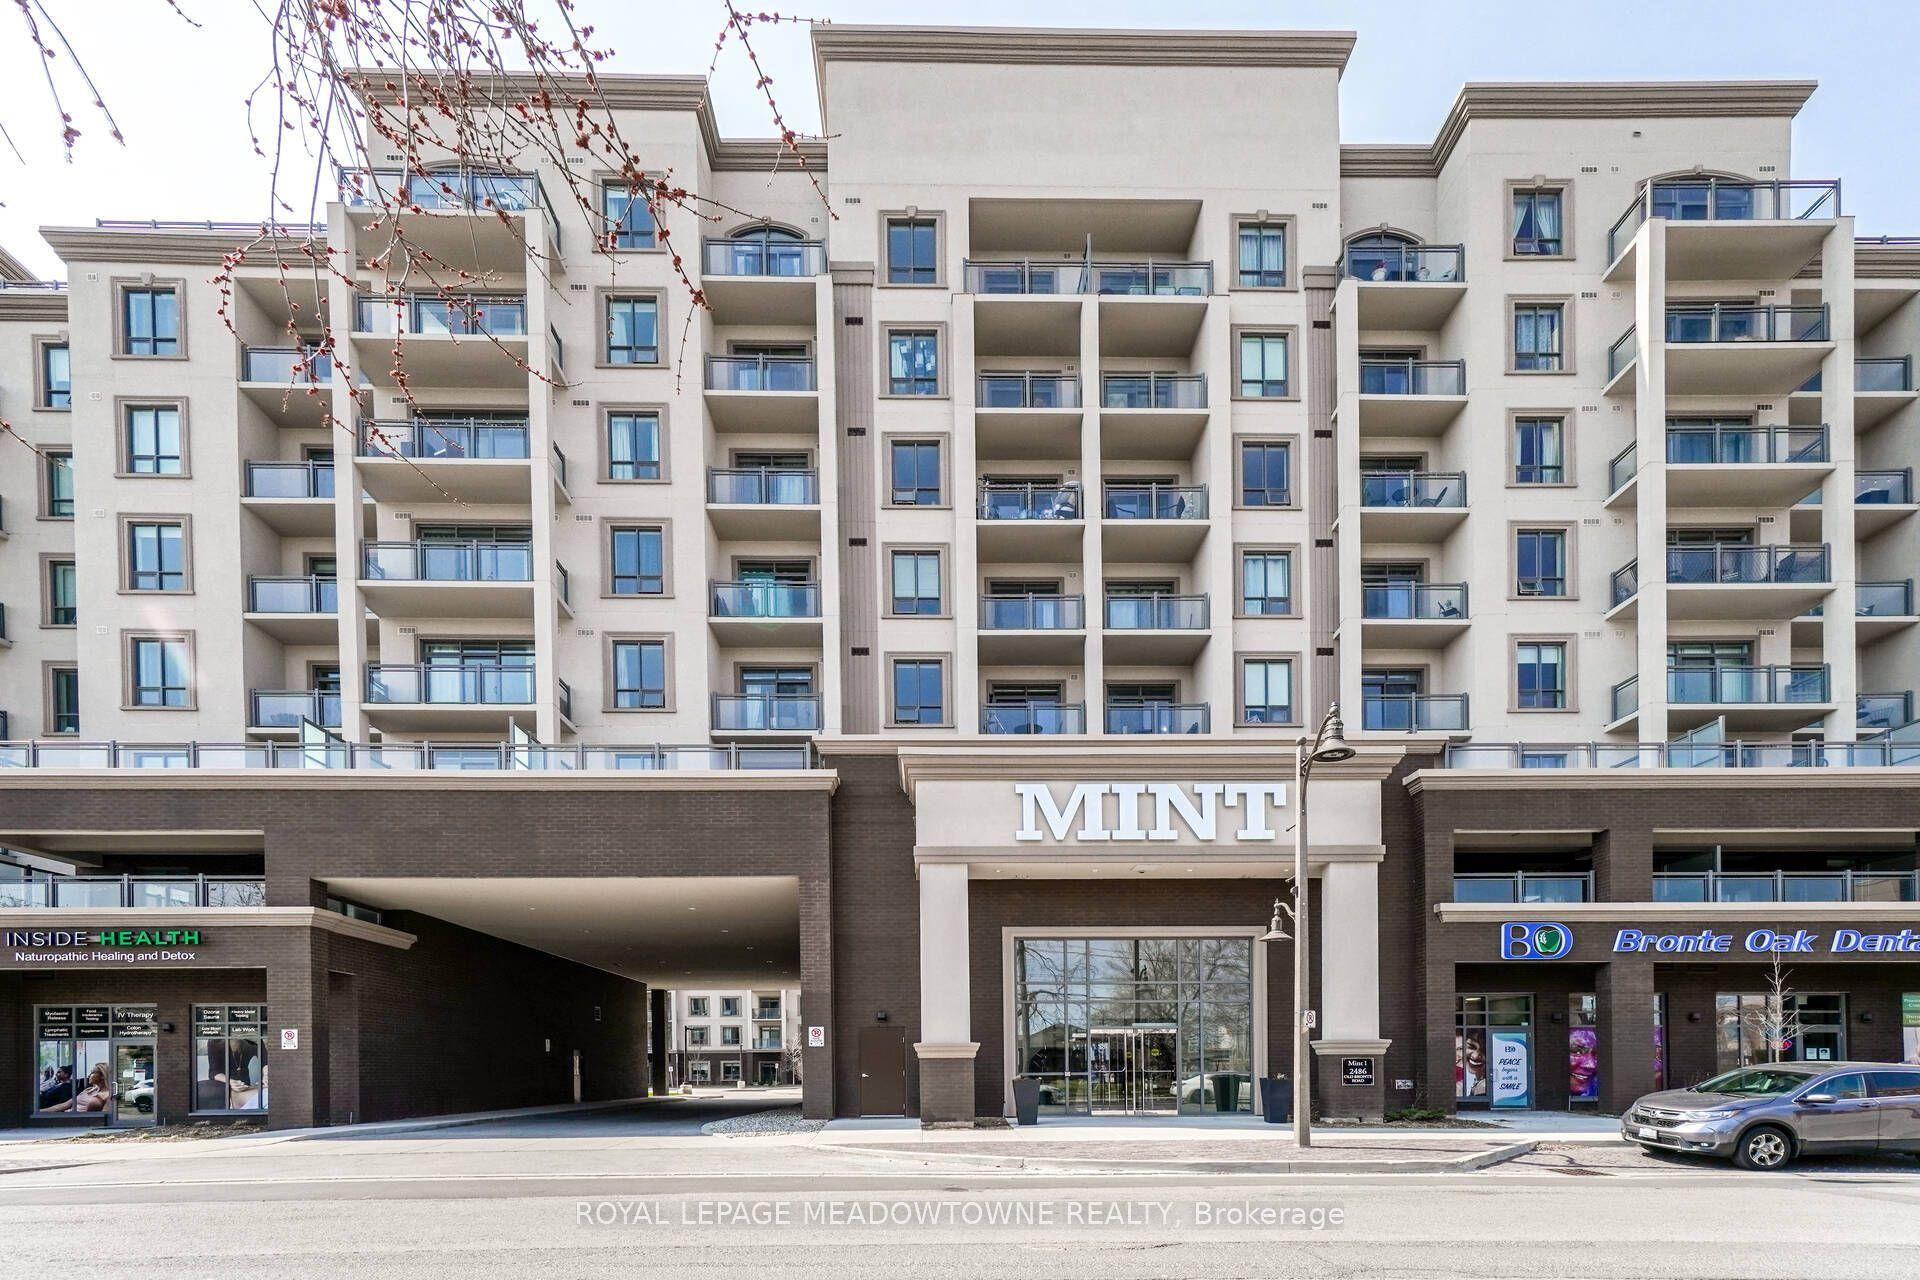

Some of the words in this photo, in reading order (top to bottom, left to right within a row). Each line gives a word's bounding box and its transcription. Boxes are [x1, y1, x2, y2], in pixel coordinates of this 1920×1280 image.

[1015, 783, 1286, 841] MINT
[6, 931, 88, 947] INSIDE
[101, 931, 199, 946] HEALTH
[1613, 929, 1733, 953] Bronte
[1745, 929, 1819, 953] Oak
[15, 952, 89, 963] Naturopathic
[92, 952, 135, 963] Healing
[137, 951, 158, 961] and
[161, 951, 196, 961] Detox
[1498, 1058, 1522, 1066] PEACE
